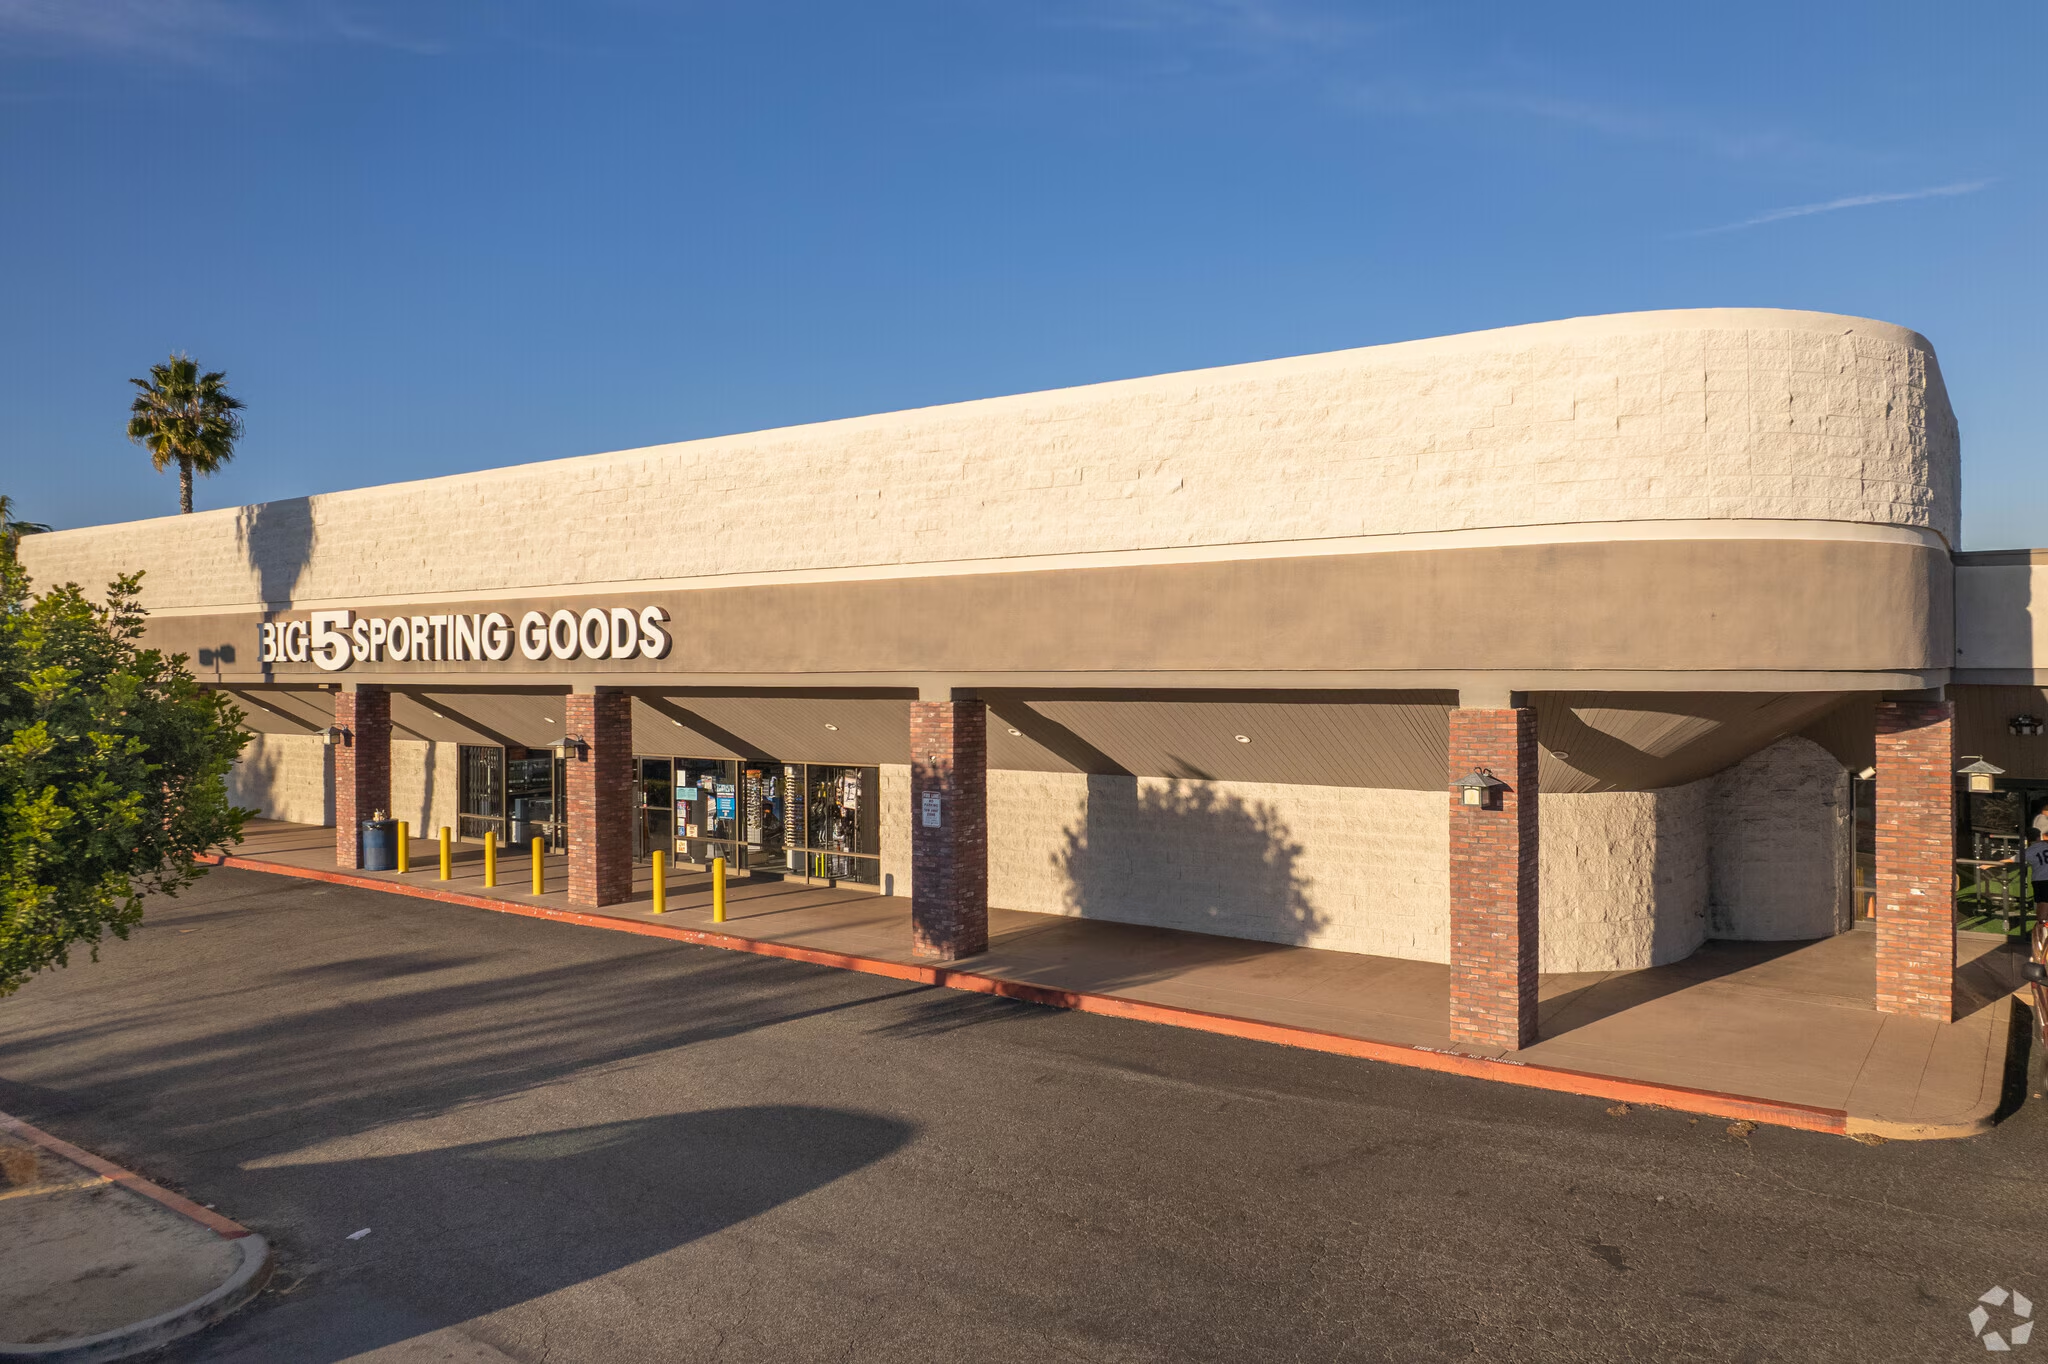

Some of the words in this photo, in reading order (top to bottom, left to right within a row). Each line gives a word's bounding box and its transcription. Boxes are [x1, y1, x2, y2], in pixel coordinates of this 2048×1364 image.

[257, 620, 309, 662] BIG
[311, 610, 353, 671] 5
[352, 612, 511, 661] SPORTING
[519, 606, 669, 660] GOODS
[1436, 1048, 1461, 1056] LANE
[1485, 1056, 1525, 1066] PARKING
